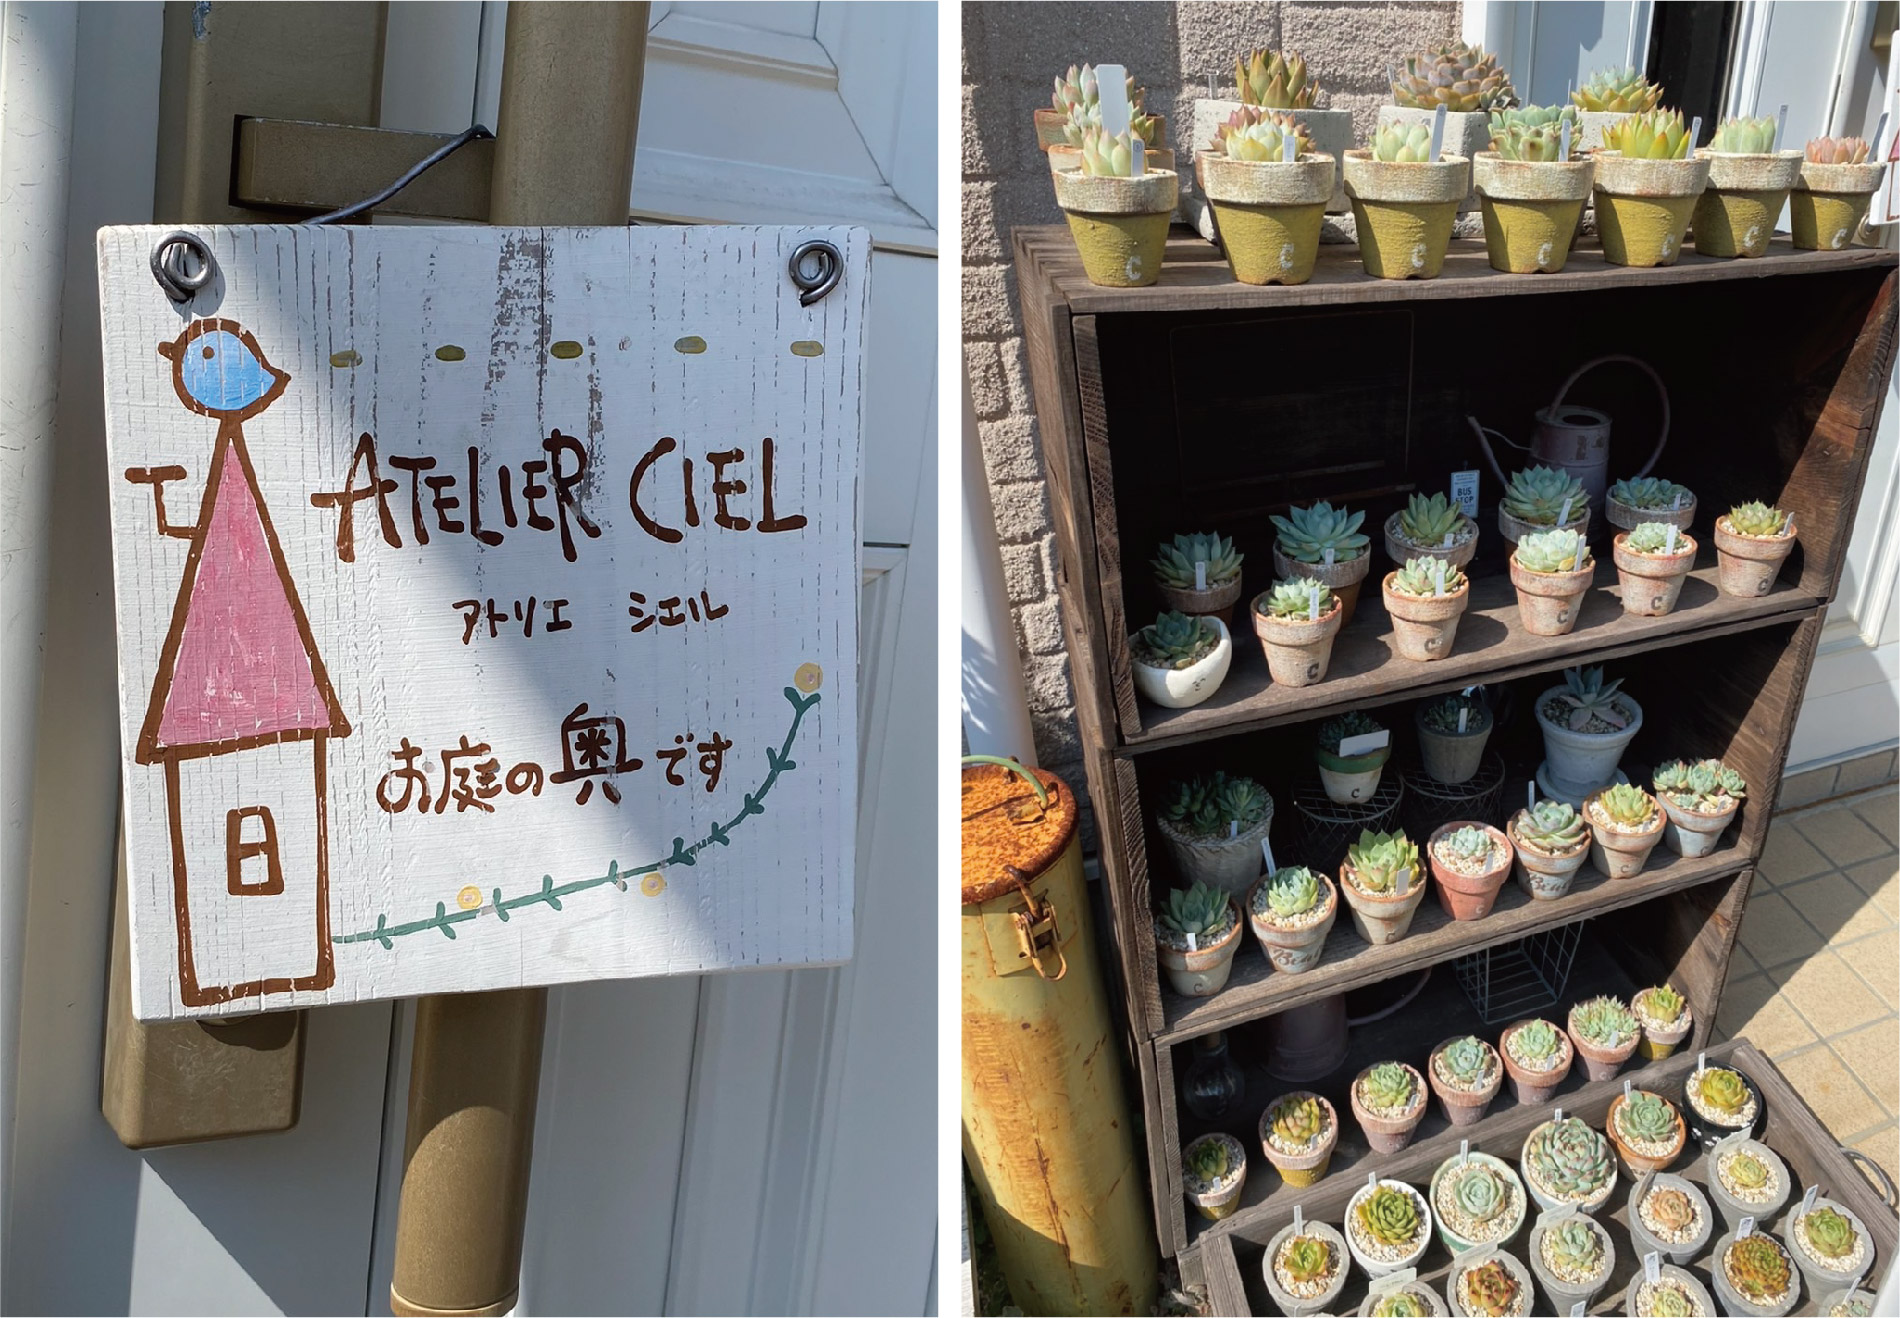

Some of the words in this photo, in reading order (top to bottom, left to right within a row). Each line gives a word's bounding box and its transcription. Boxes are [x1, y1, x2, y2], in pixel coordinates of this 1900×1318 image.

[1743, 226, 1759, 248] C
[1831, 228, 1848, 249] C
[1538, 243, 1552, 265] C
[1126, 256, 1141, 280] C
[310, 428, 602, 563] ATELIER
[629, 436, 808, 544] CIEL
[1457, 487, 1472, 497] BUS
[1758, 578, 1768, 592] C
[1651, 596, 1663, 610] C
[452, 596, 572, 645] アトリエ
[629, 590, 729, 633] シエル
[1557, 611, 1568, 624] C
[1307, 662, 1319, 679] C
[376, 702, 733, 814] お庭の奥です
[1351, 788, 1360, 799] C
[1620, 864, 1630, 873] C
